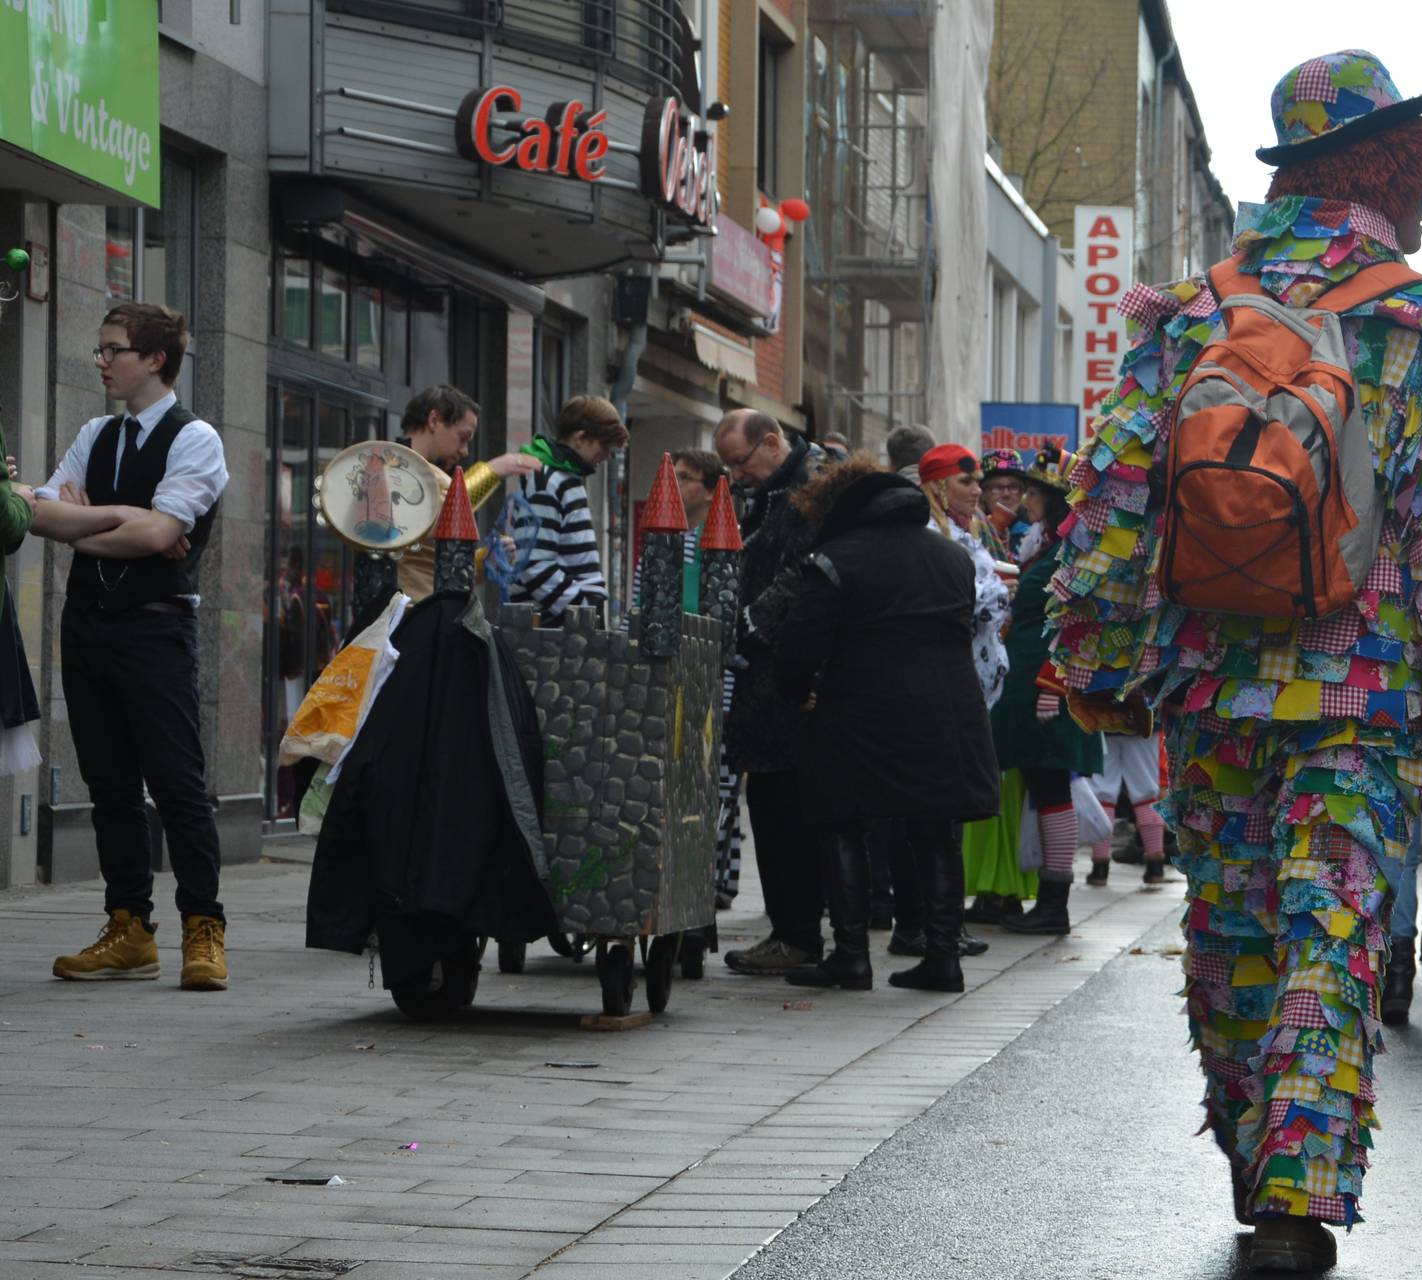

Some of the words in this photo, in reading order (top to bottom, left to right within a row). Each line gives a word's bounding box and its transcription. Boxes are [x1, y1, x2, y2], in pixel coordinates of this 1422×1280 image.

[31, 61, 49, 125] &
[56, 68, 151, 186] Vintage
[473, 85, 609, 182] Café
